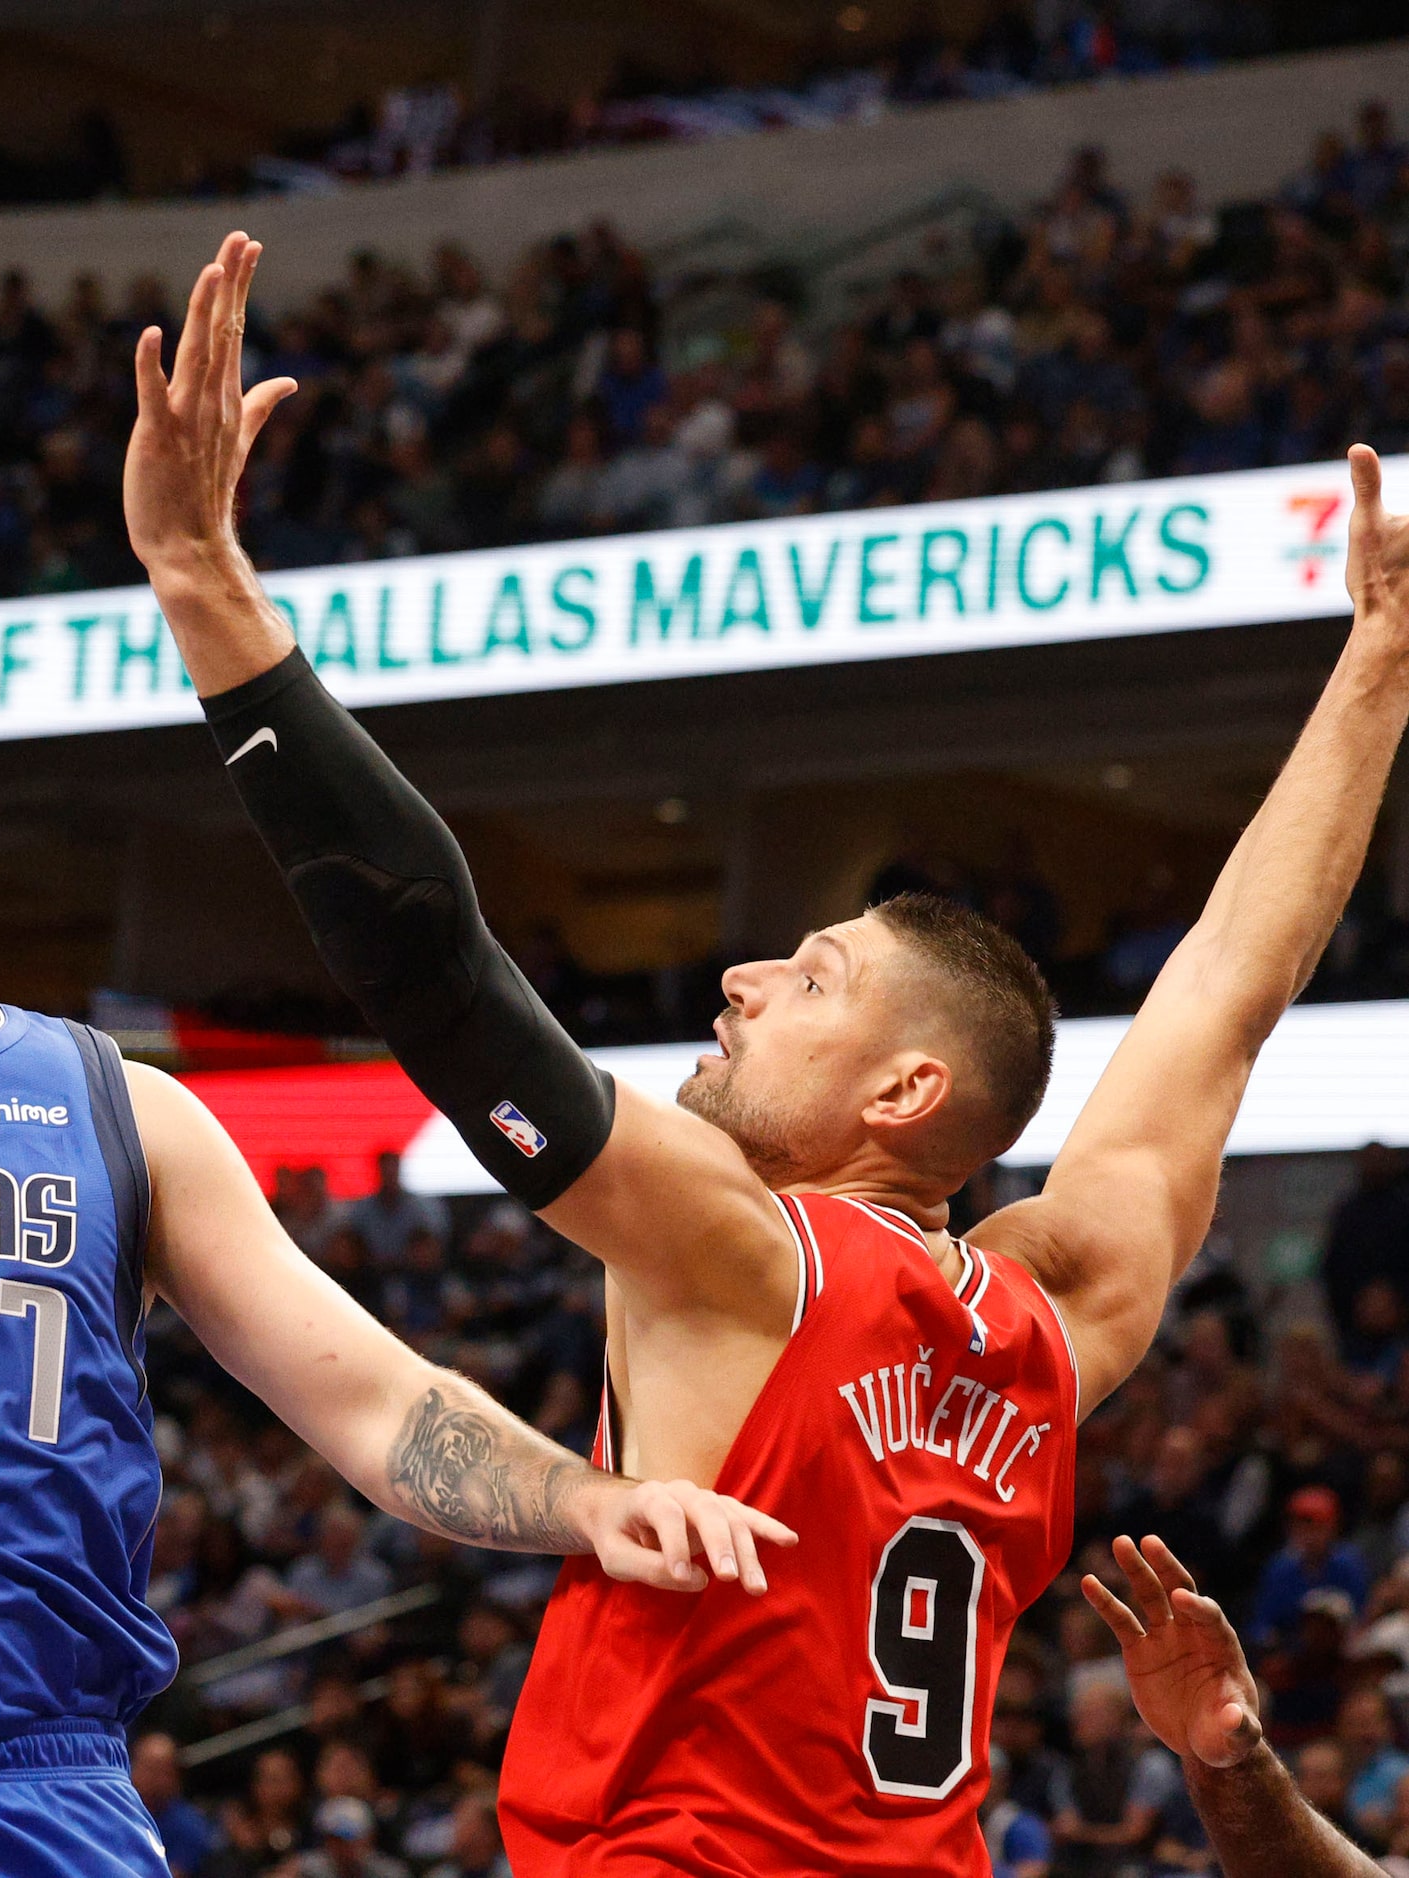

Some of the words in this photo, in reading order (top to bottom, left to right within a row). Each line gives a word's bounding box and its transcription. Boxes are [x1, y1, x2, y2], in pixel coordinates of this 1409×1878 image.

[64, 607, 194, 697] TH
[628, 501, 1212, 650] MAVERICKS
[838, 1344, 1051, 1502] VUČEVIĆ
[862, 1515, 986, 1800] 9
